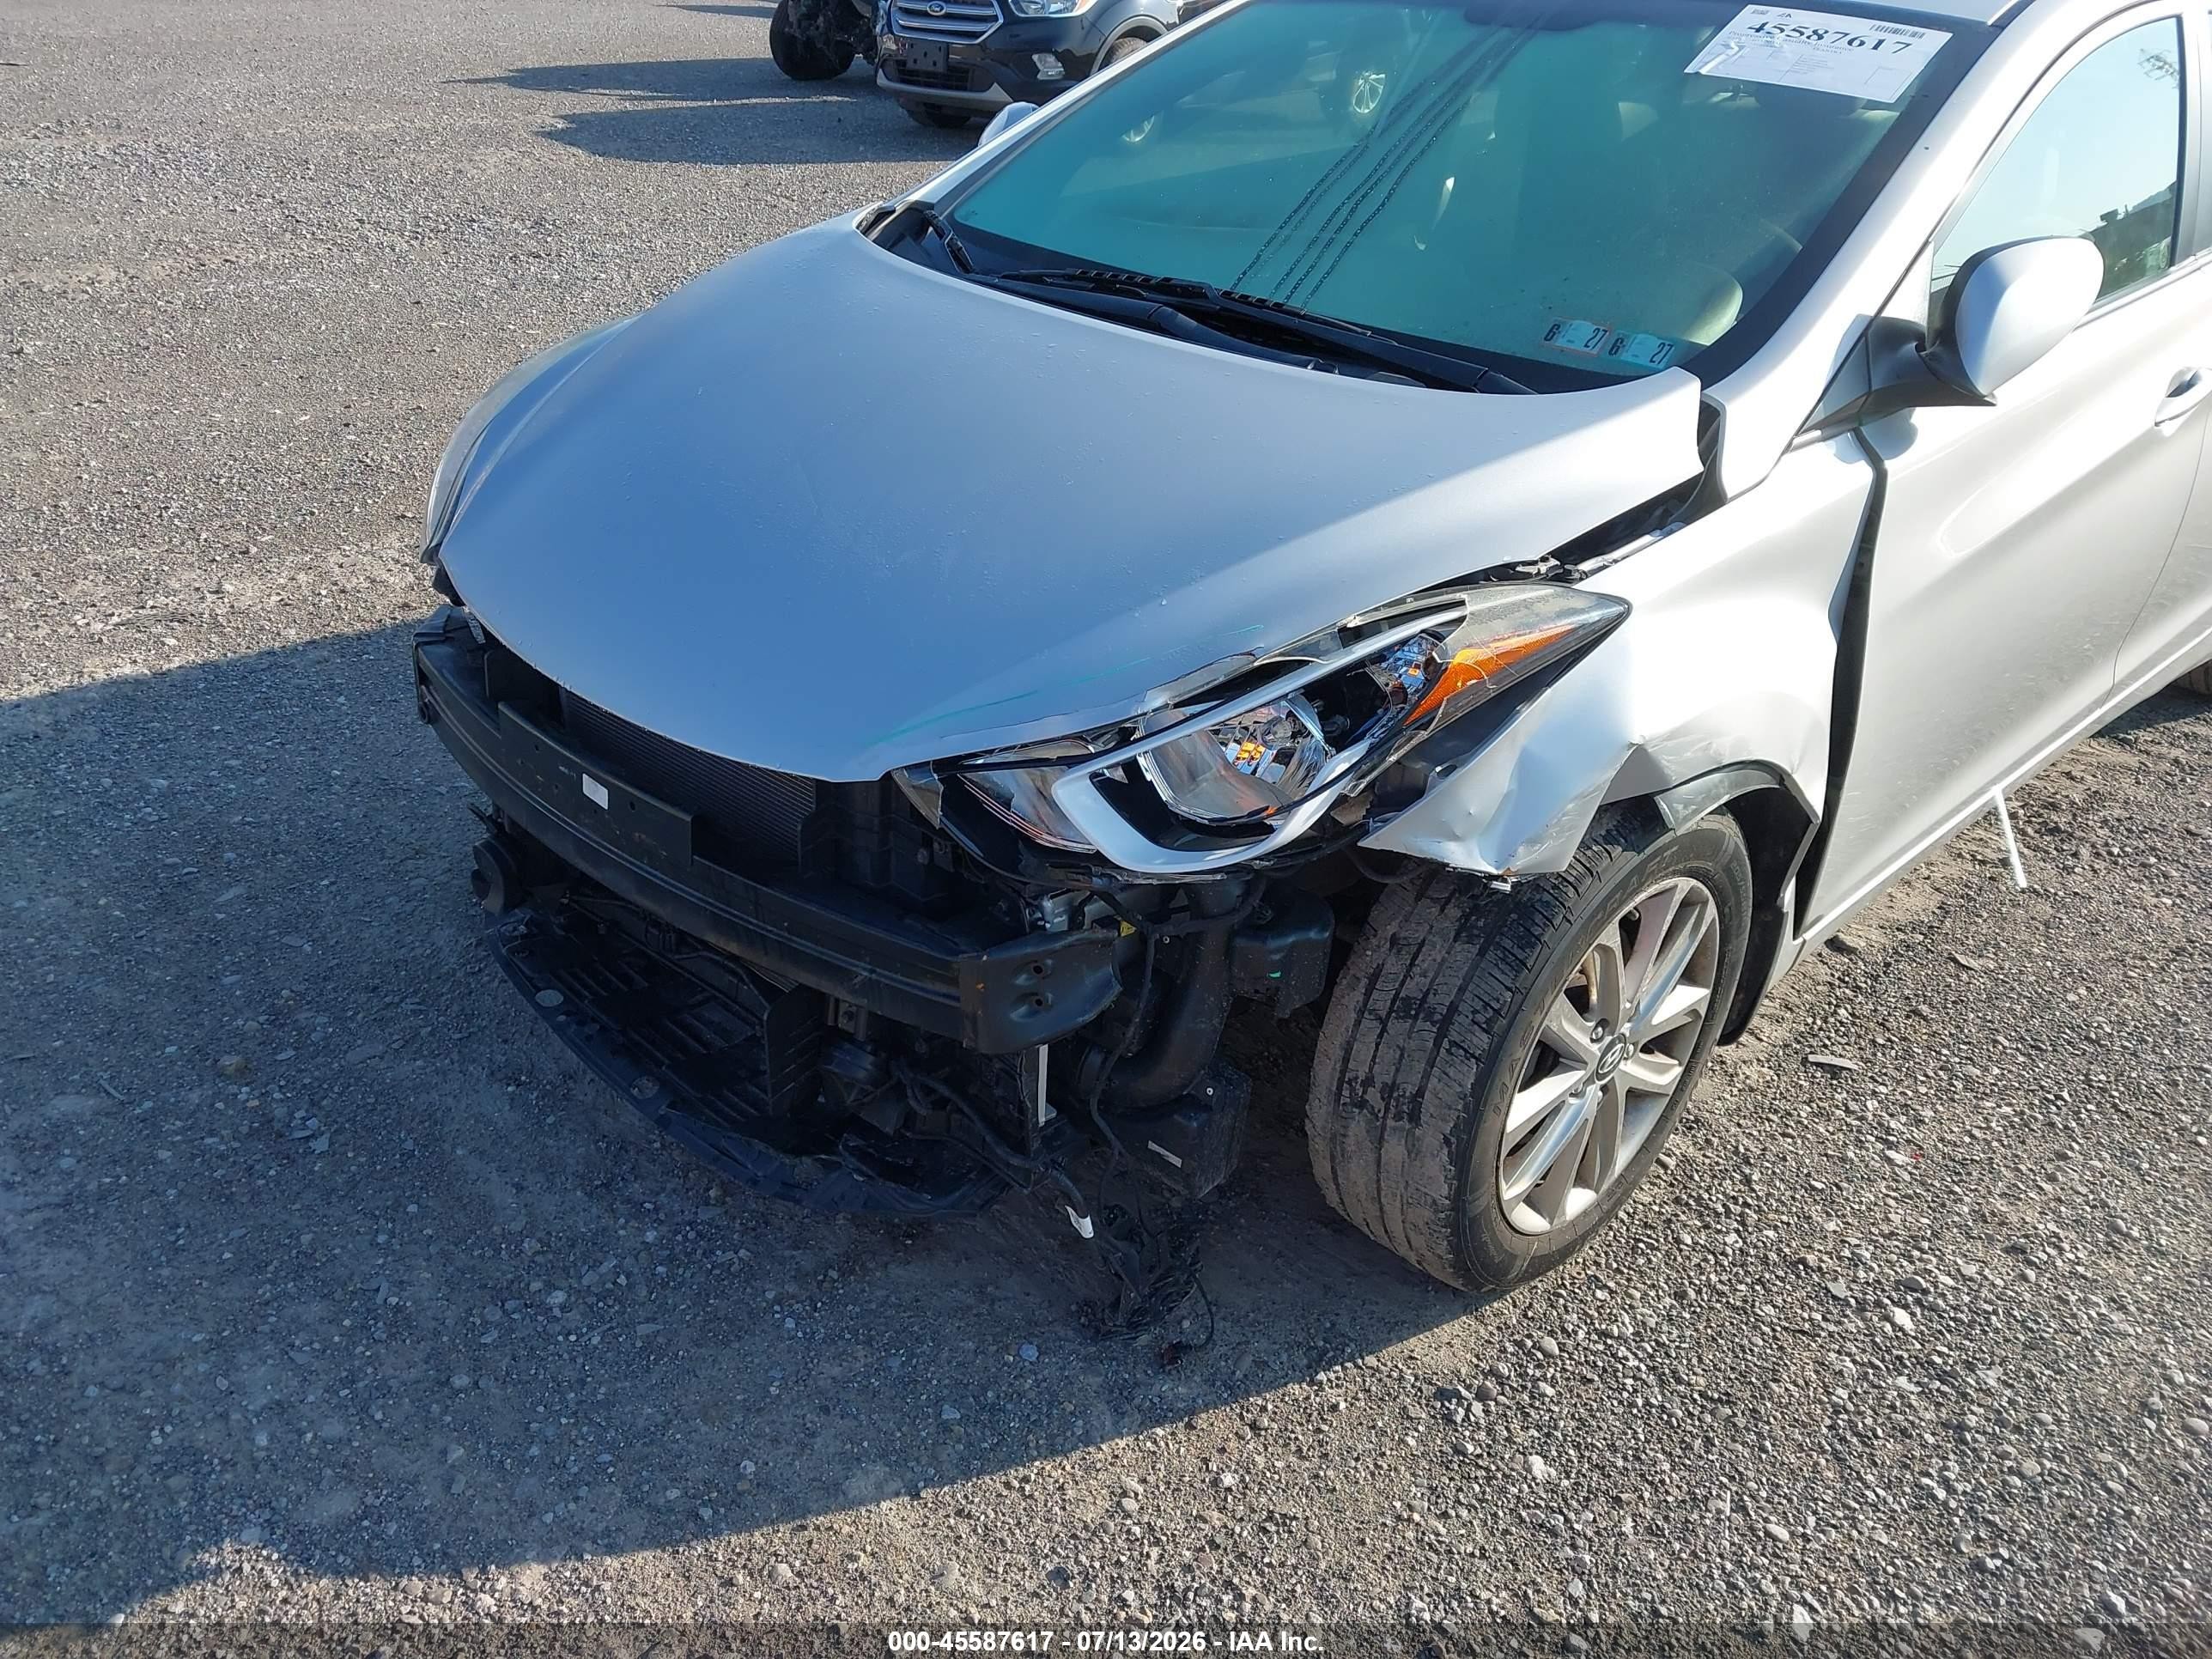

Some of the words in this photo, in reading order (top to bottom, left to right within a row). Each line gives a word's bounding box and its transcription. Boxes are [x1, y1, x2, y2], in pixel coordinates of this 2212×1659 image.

[1747, 21, 1913, 54] 45587617
[1583, 327, 1608, 349] 27
[1650, 342, 1674, 364] 27
